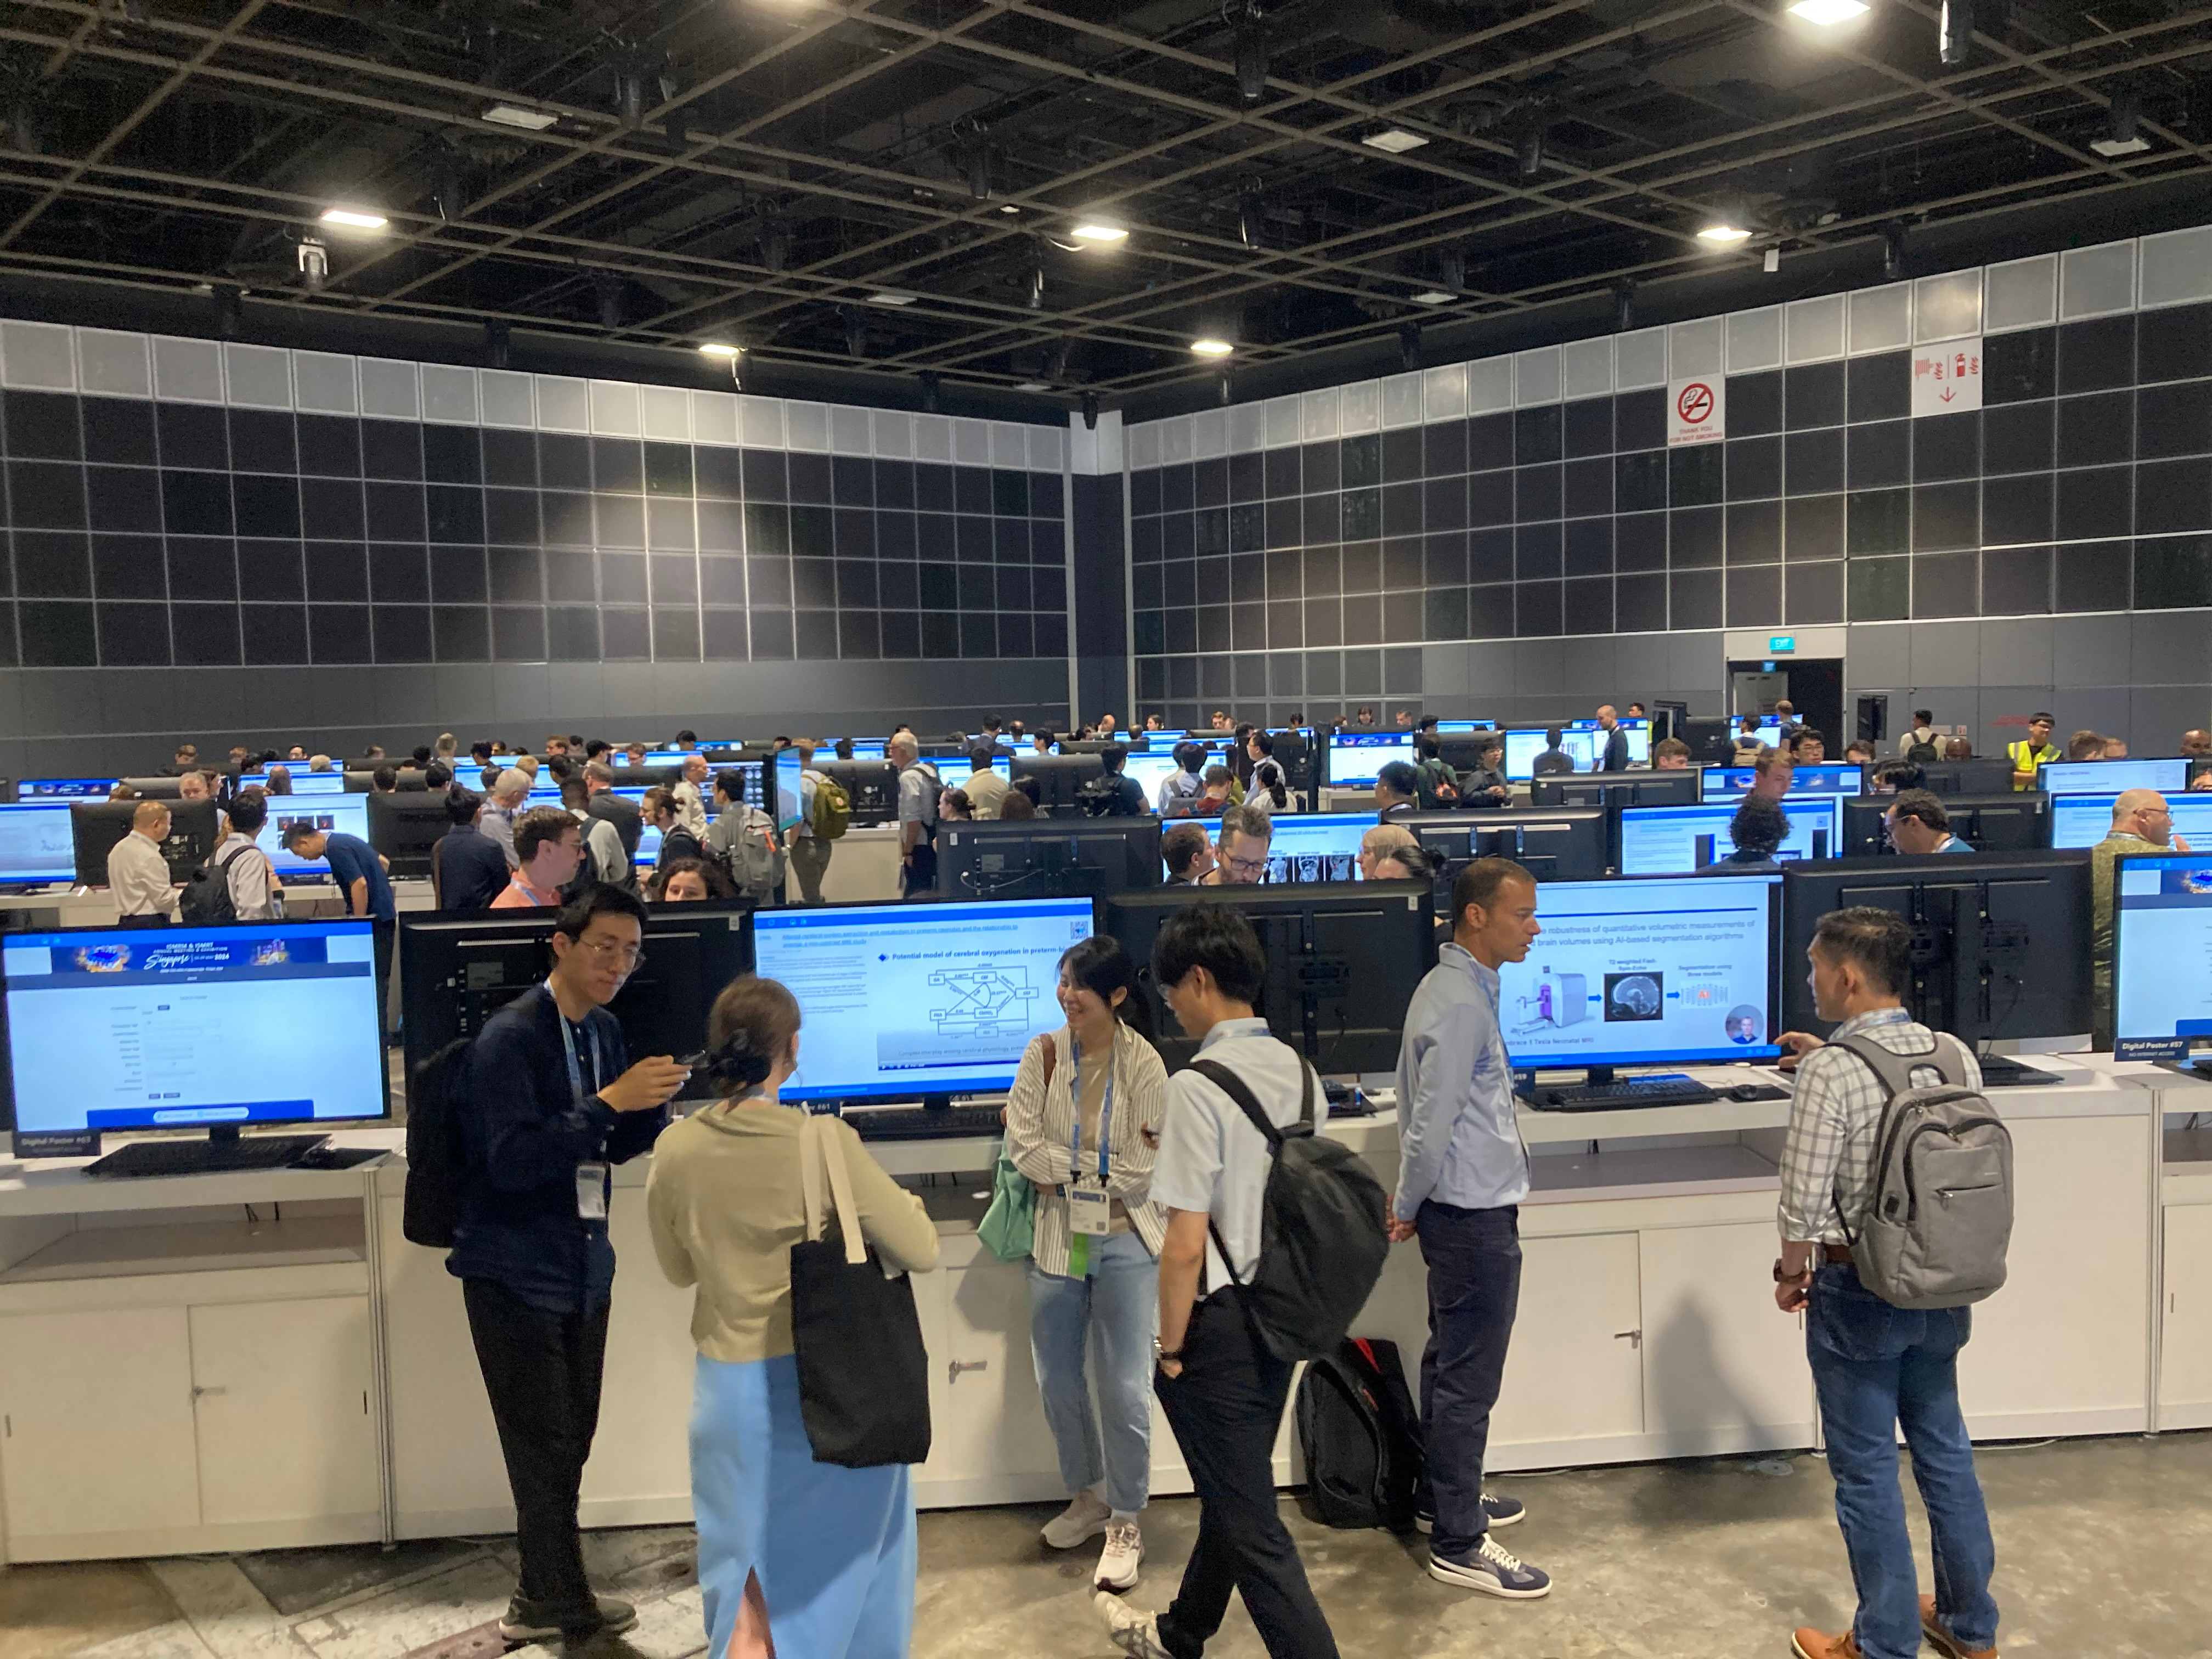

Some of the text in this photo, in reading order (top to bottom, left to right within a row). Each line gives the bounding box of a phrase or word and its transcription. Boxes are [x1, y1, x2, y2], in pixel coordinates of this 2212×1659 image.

[1602, 924, 1646, 933] quantitative
[1593, 936, 1613, 945] using
[1615, 935, 1650, 944] AI-based
[1652, 934, 1702, 943] segmentation
[1705, 933, 1743, 941] algorithms
[892, 952, 921, 961] Potential
[923, 950, 943, 959] model
[953, 949, 980, 957] cerebral
[981, 948, 1021, 957] oxygenation
[1030, 945, 1066, 955] preterm-bi
[144, 954, 190, 970] Singapore
[1698, 990, 1710, 1000] AI
[2122, 1042, 2145, 1051] Digital
[21, 1137, 47, 1146] Digital
